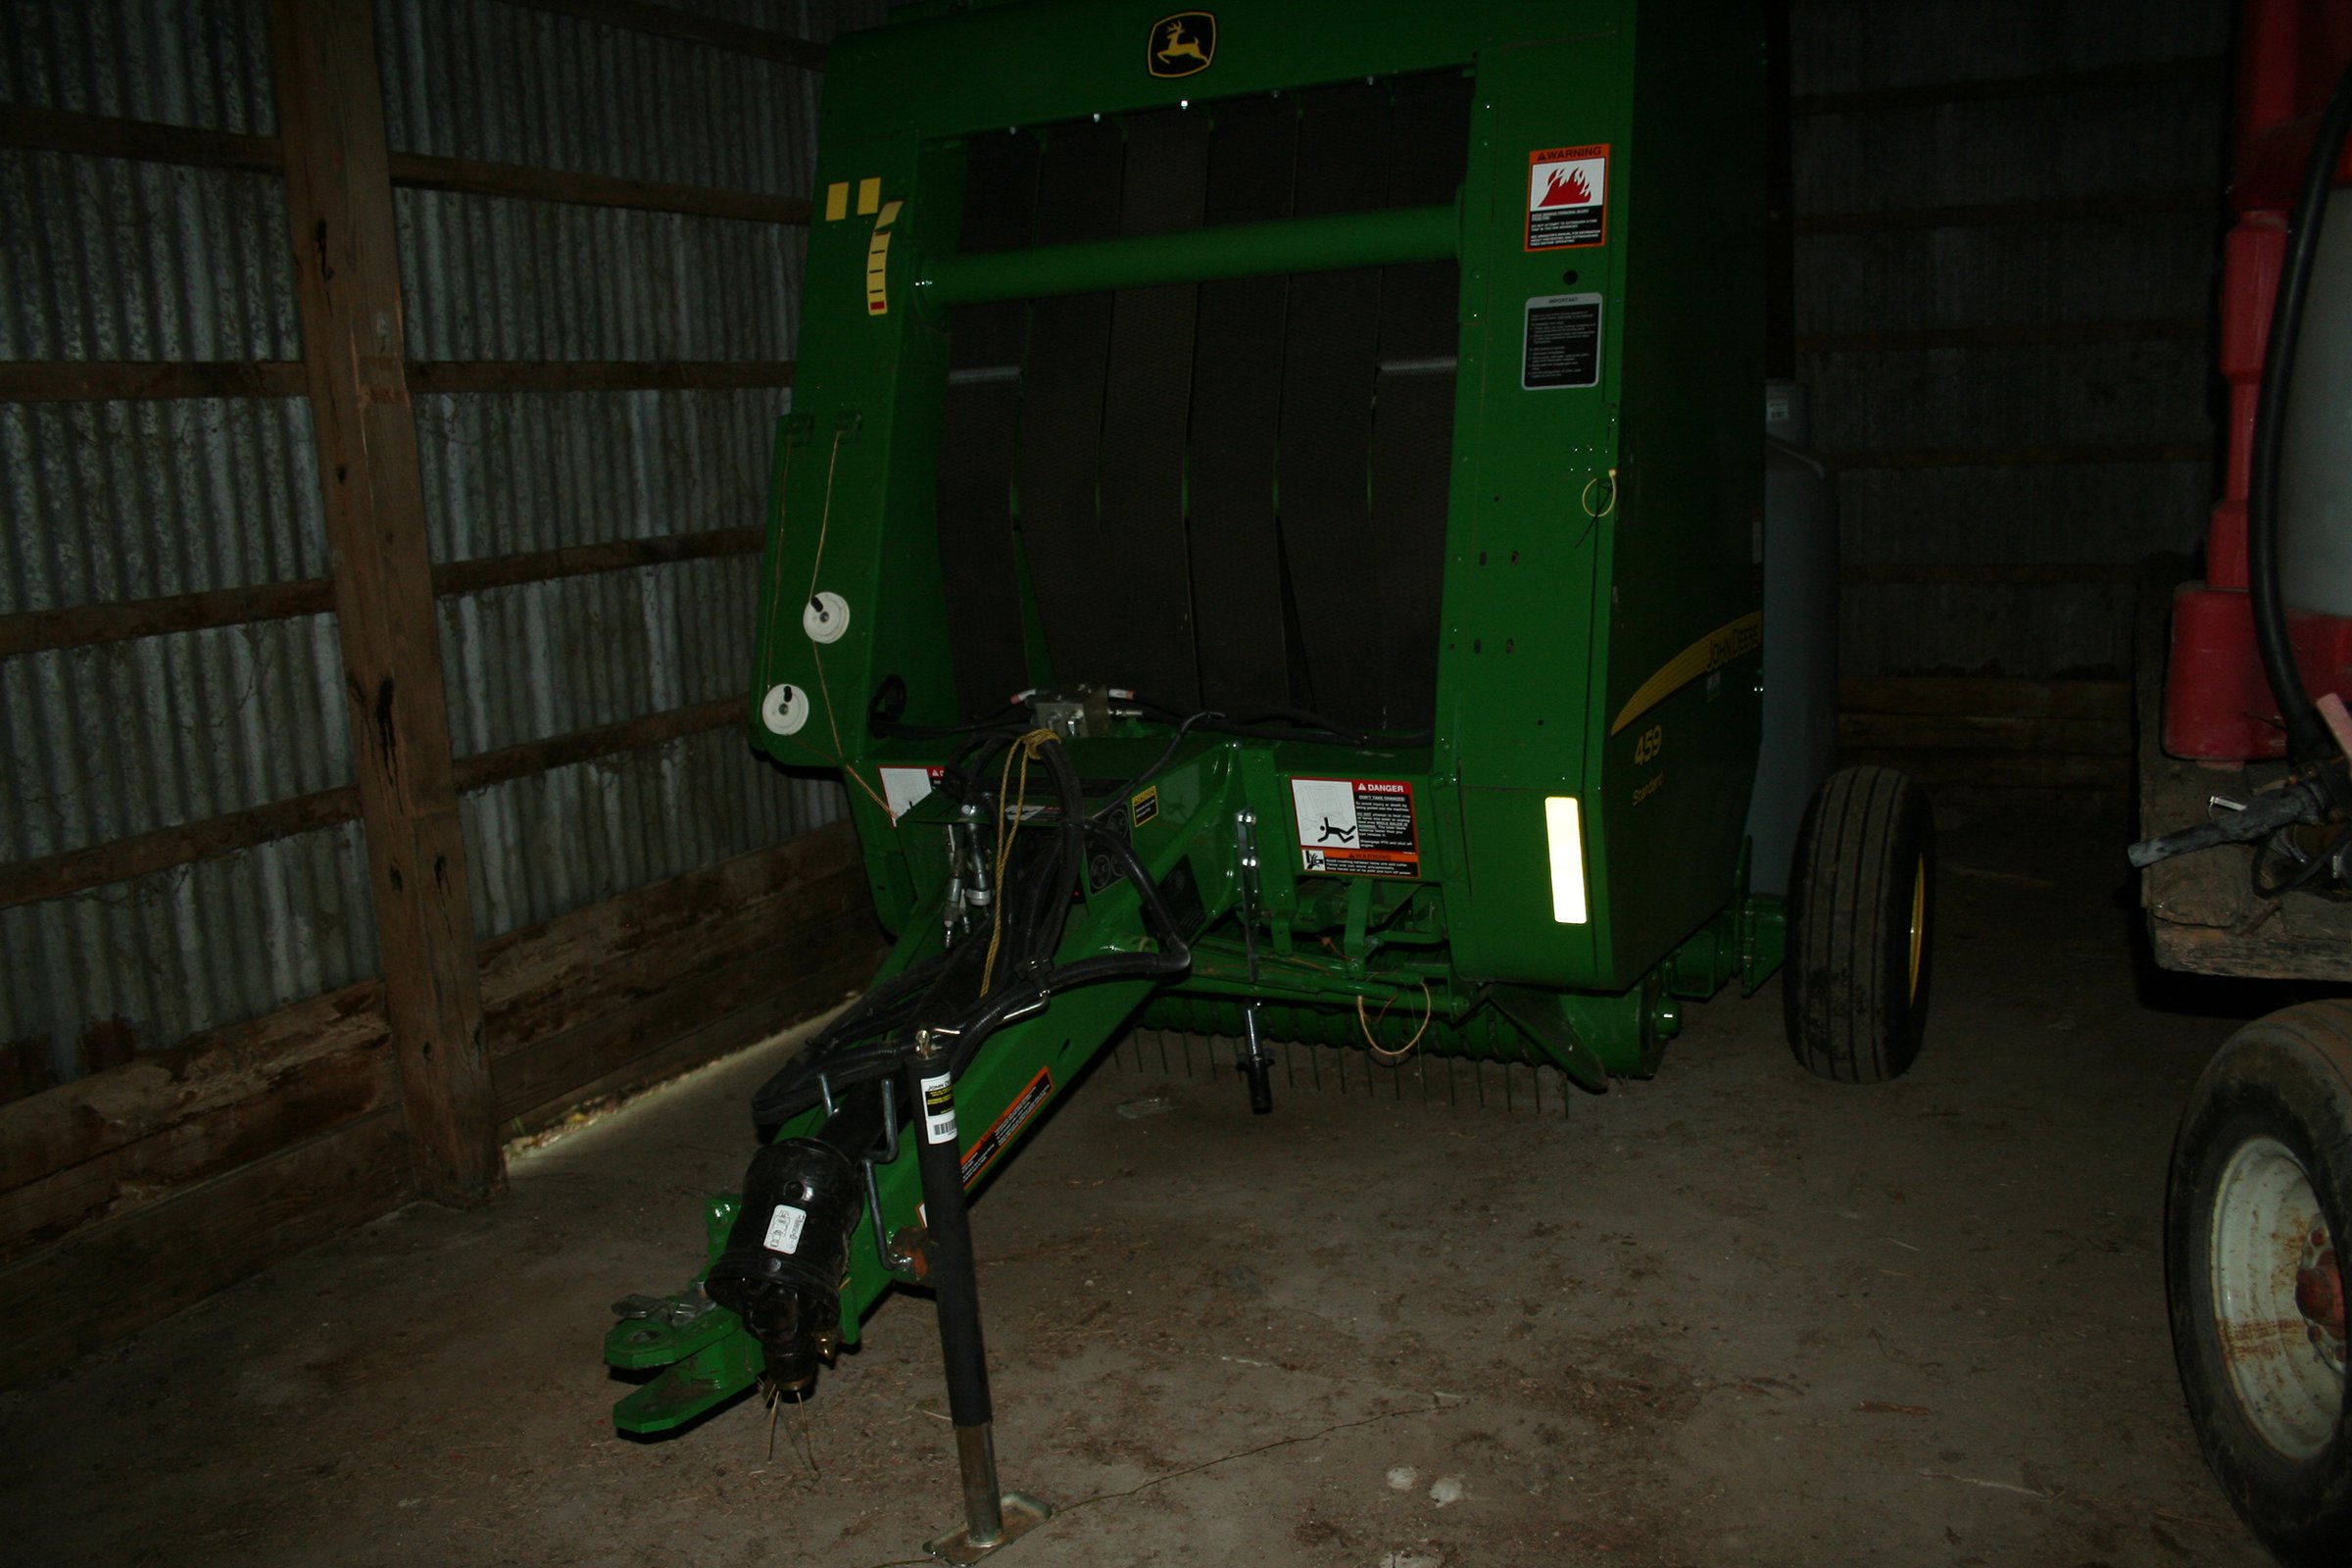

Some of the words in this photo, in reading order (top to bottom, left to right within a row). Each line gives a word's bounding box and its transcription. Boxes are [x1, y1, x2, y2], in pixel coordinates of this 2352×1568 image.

[1547, 146, 1602, 160] WARNING
[1706, 637, 1732, 671] JOHN
[1634, 723, 1662, 766] 459
[1367, 784, 1404, 793] DANGER
